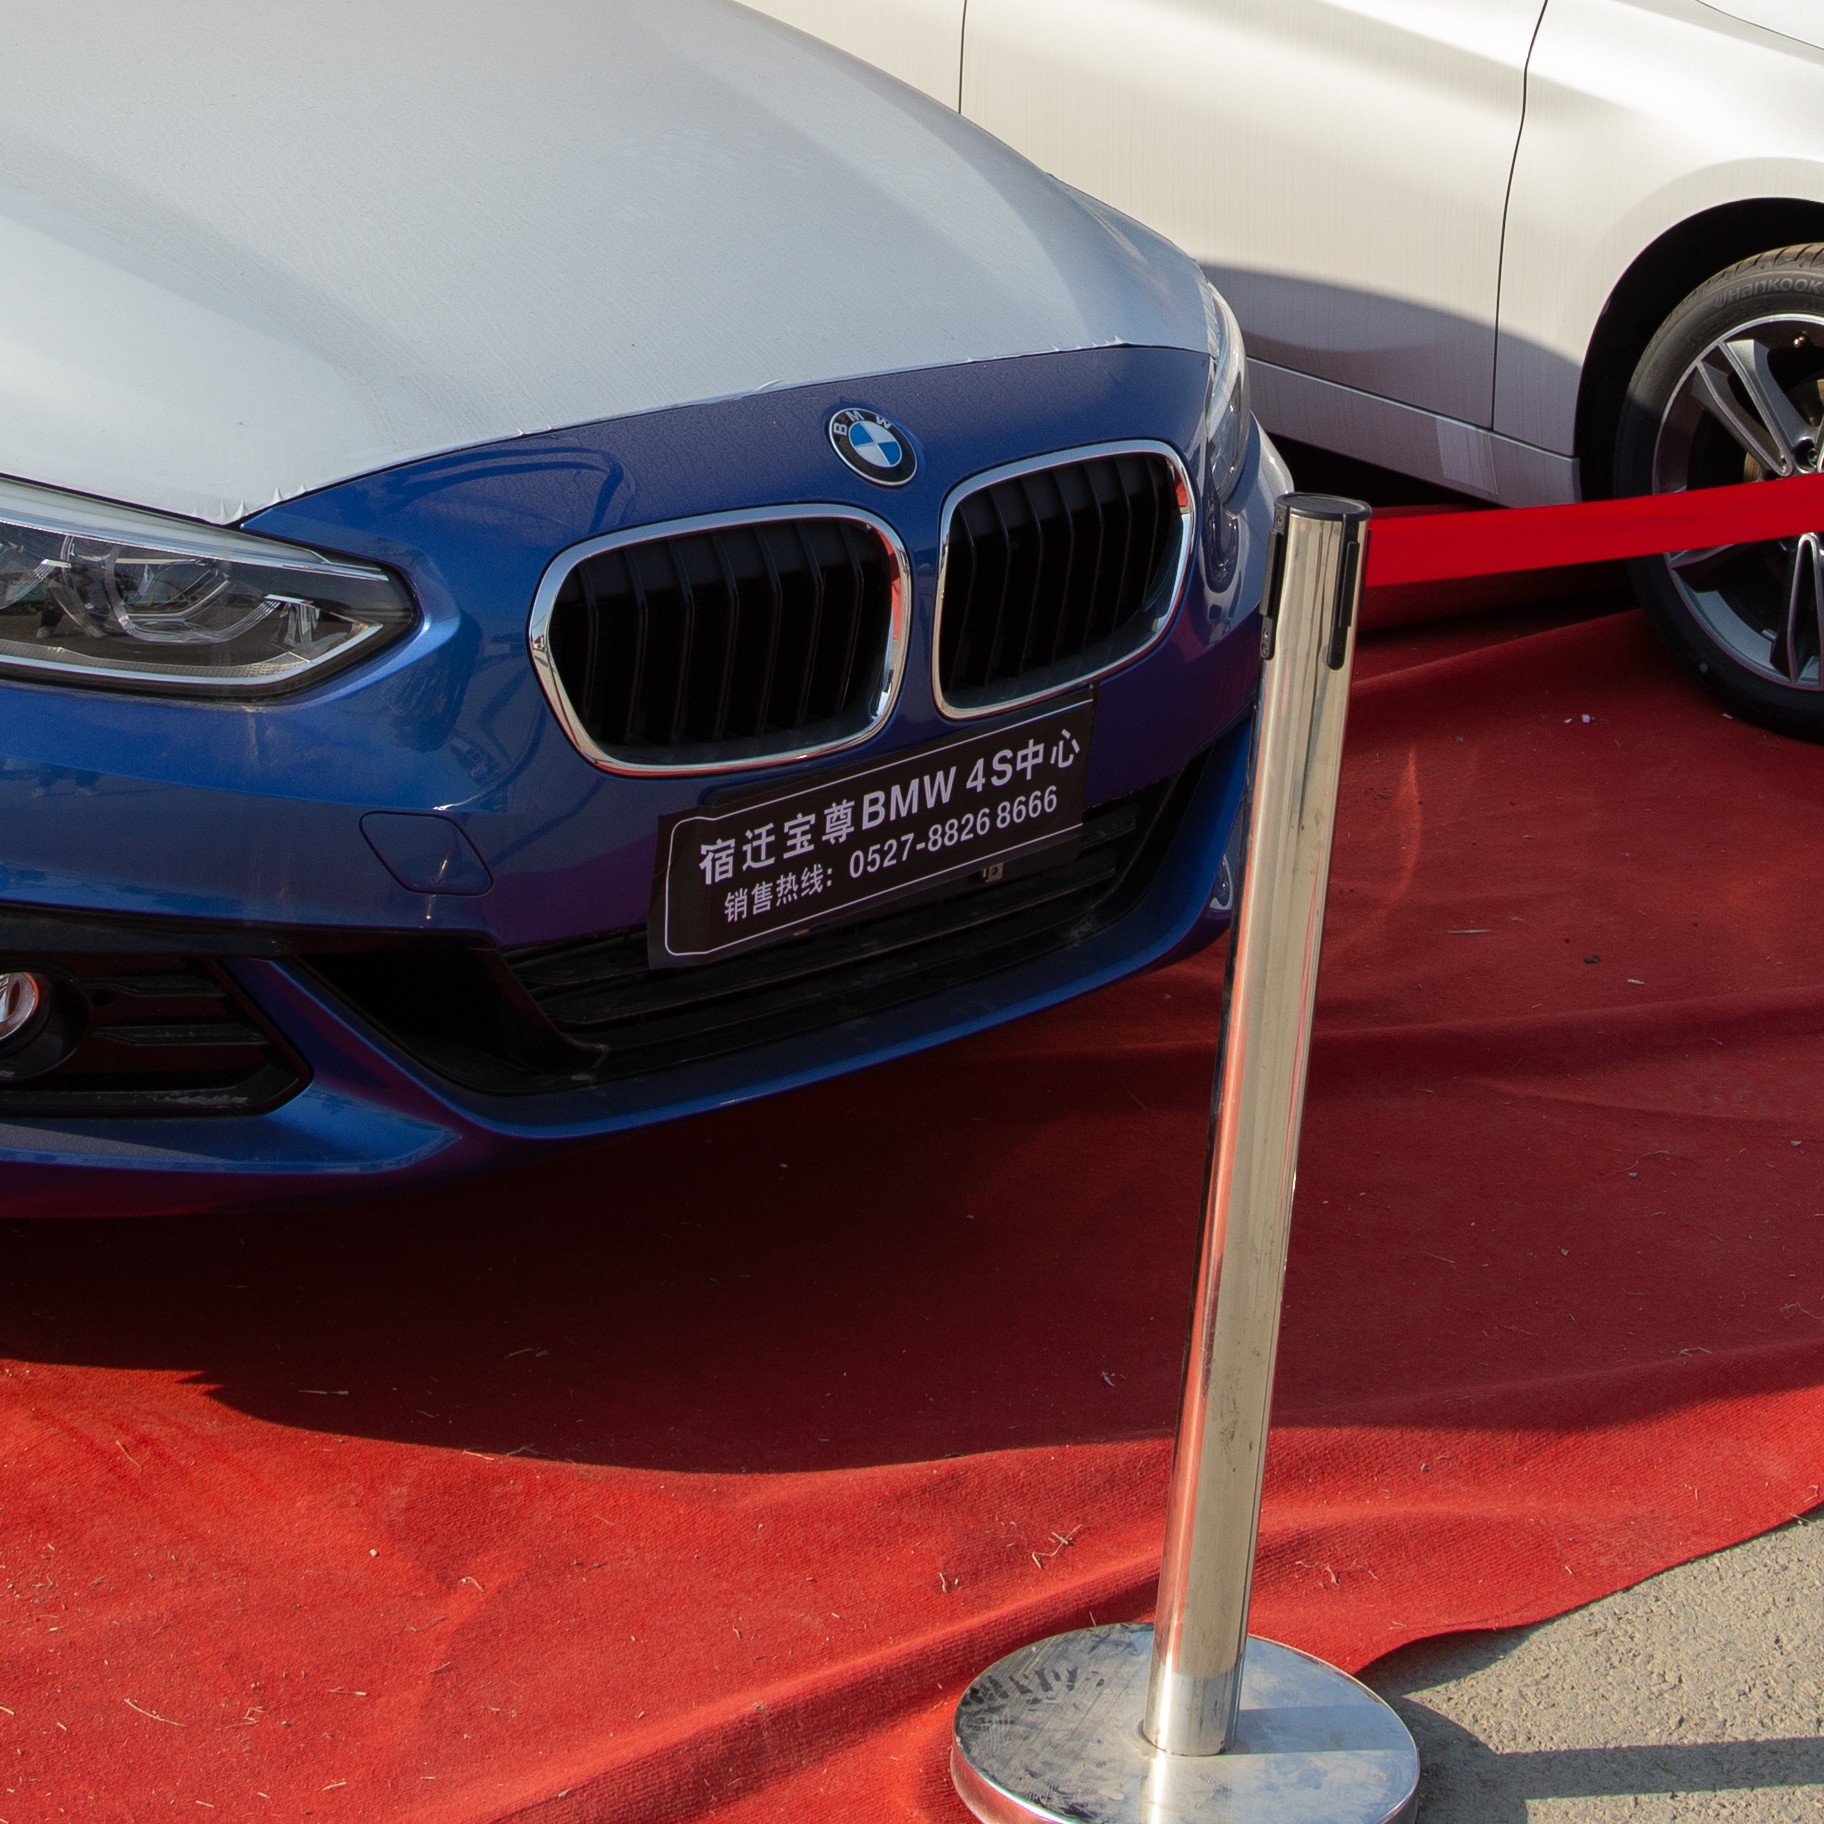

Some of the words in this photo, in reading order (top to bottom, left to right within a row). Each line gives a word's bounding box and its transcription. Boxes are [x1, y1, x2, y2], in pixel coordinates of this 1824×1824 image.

[832, 409, 893, 437] BMW
[699, 766, 958, 886] 宿迁宝尊BMW
[965, 728, 1082, 793] 4S中心
[849, 807, 991, 879] 0527-8826
[995, 784, 1058, 829] 8666
